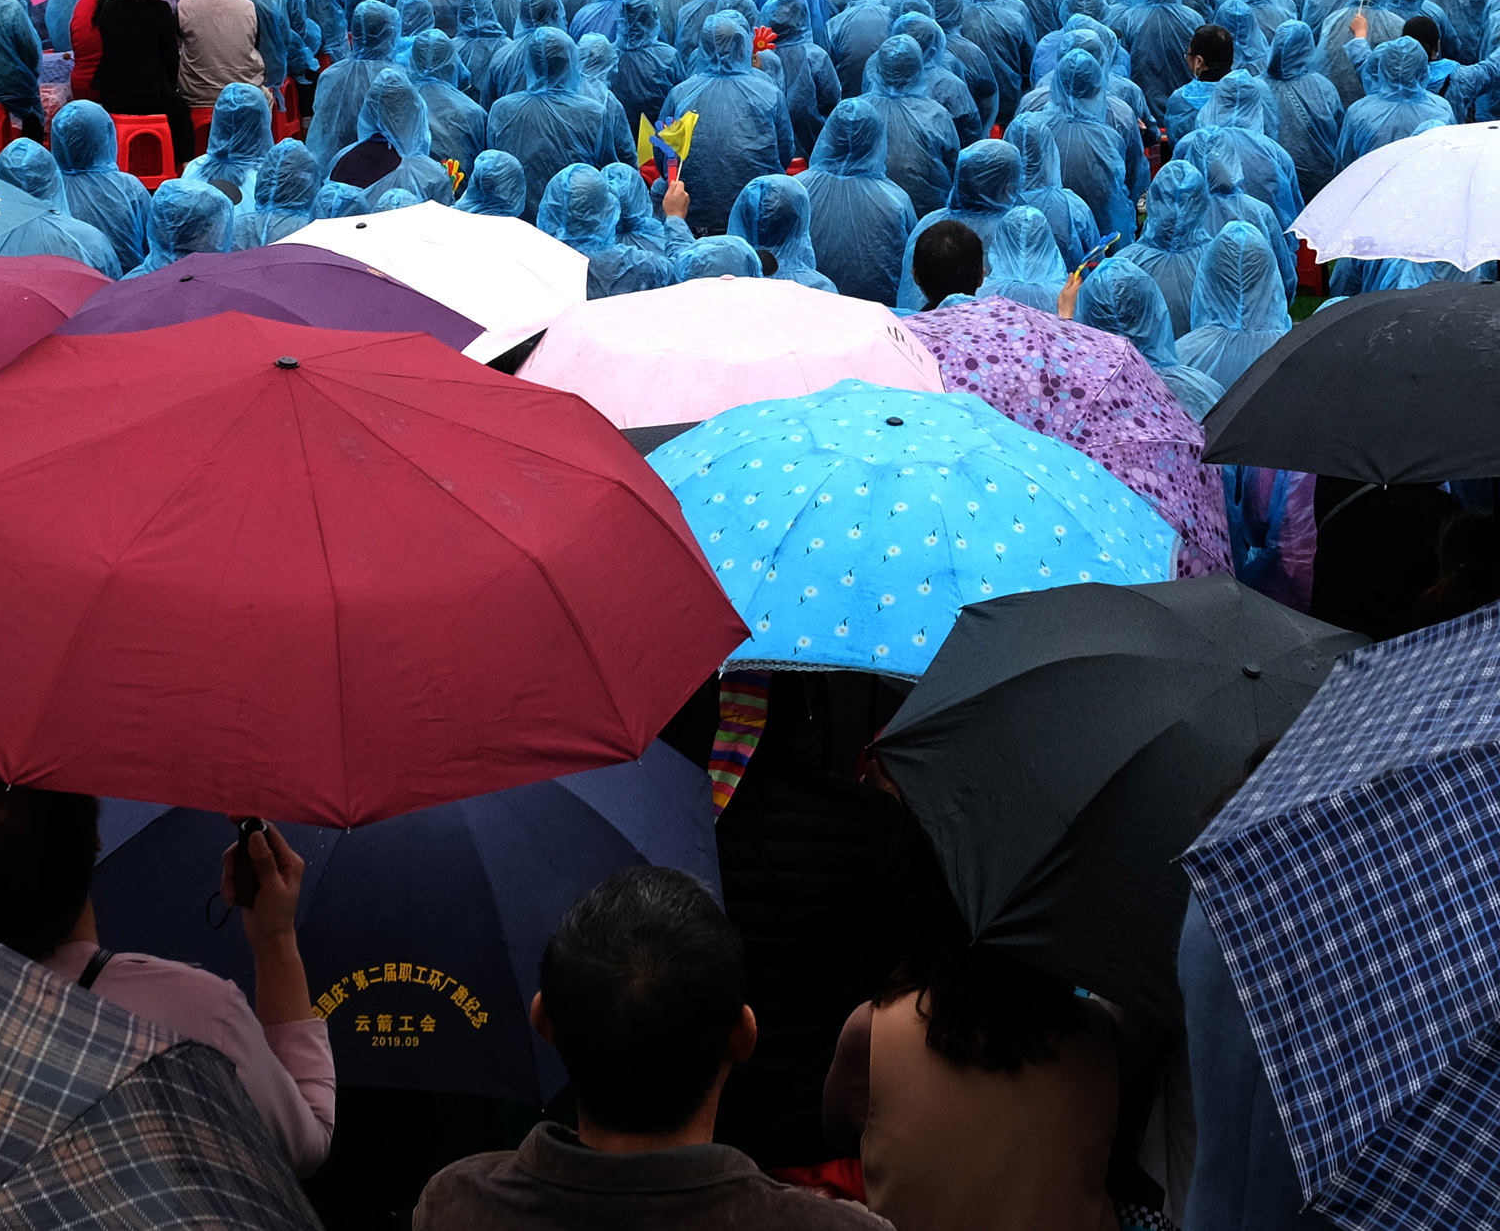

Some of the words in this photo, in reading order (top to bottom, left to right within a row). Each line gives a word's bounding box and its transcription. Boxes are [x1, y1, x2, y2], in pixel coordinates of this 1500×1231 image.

[355, 1014, 437, 1033] 云箭工会
[371, 1036, 420, 1047] 2019.09
